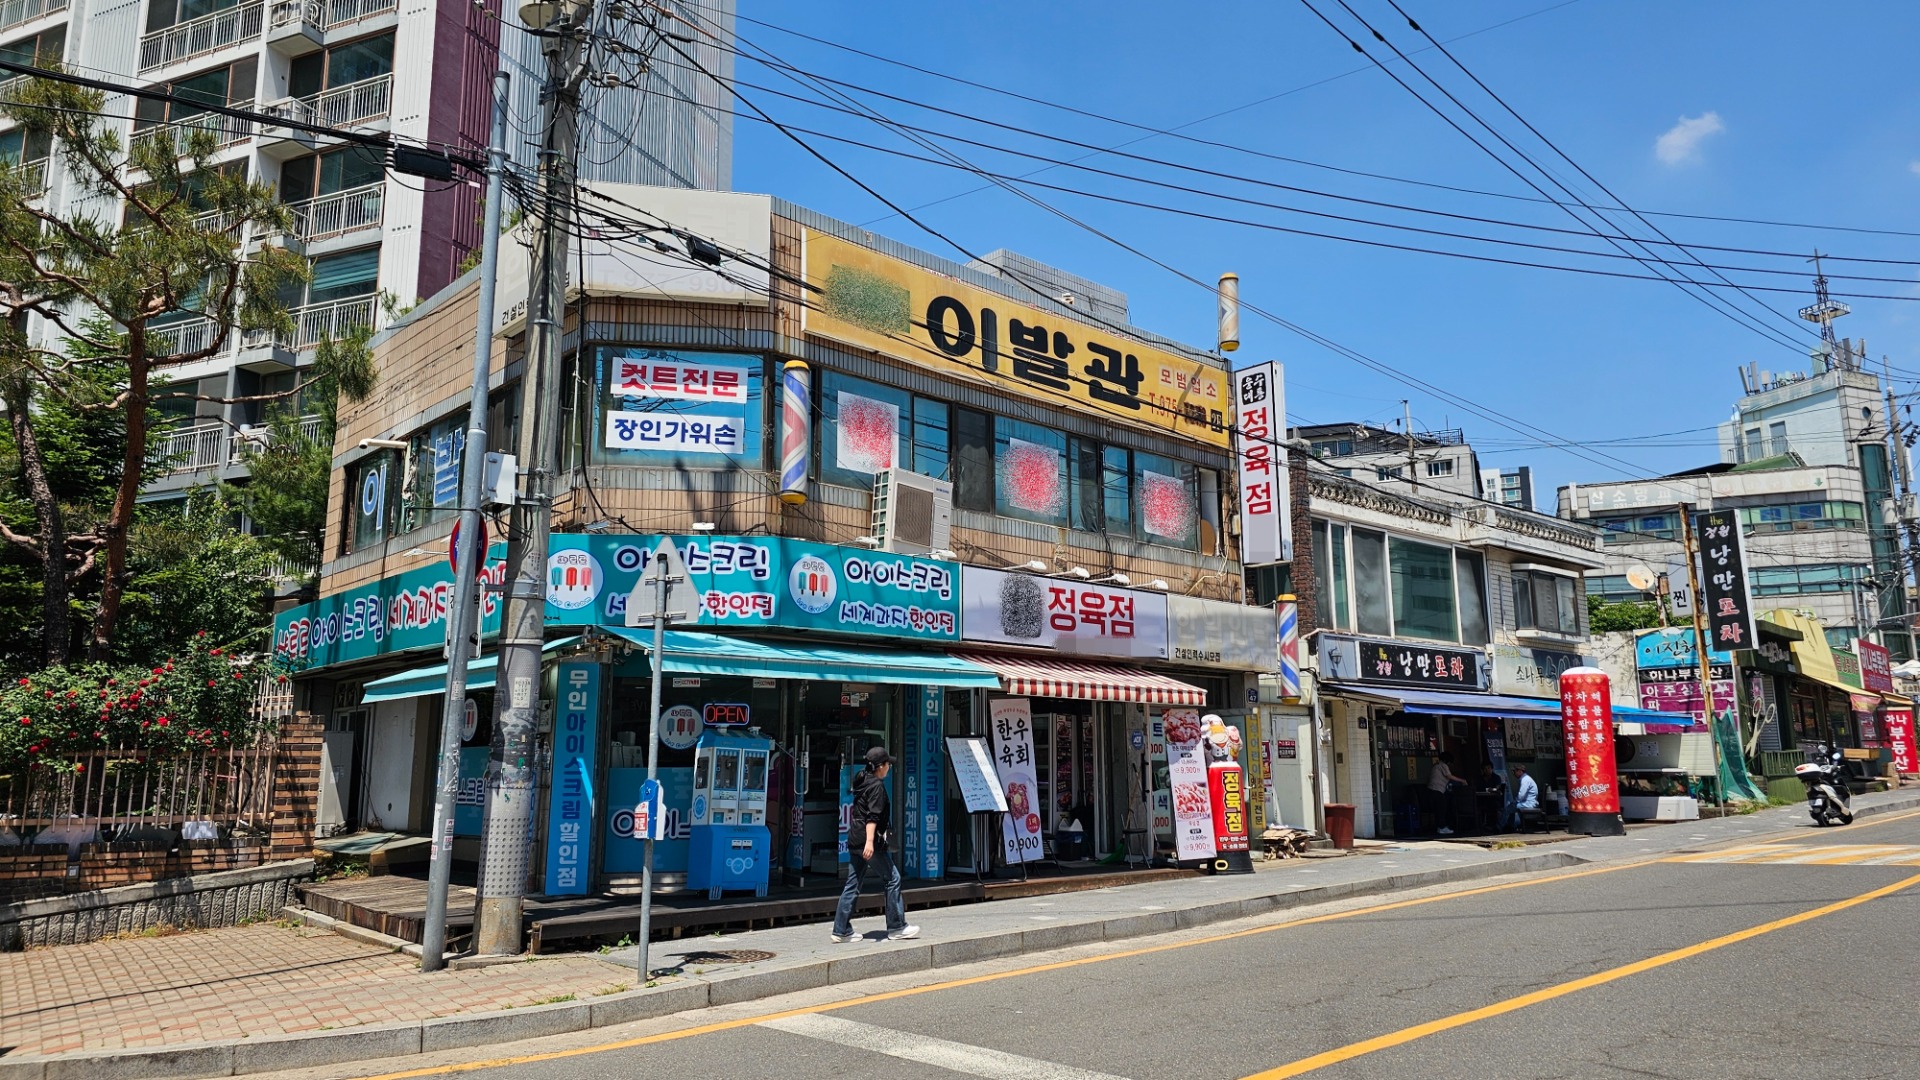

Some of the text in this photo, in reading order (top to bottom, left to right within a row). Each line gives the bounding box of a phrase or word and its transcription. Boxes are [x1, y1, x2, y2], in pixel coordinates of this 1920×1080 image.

[926, 295, 1145, 410] 이발관
[621, 363, 739, 397] 컷트전문
[1160, 368, 1217, 398] 모범업소
[614, 418, 736, 446] 장인가위손
[1242, 406, 1272, 514] 정육점
[1705, 525, 1730, 538] 정원
[1710, 517, 1723, 526] the
[617, 544, 767, 578] 아스크림
[846, 560, 950, 597] 아이스크림
[609, 592, 773, 617] 세할인점
[1710, 545, 1744, 643] 낭만포차
[841, 603, 954, 633] 세계과자할인점
[1048, 586, 1136, 638] 정육점
[1400, 651, 1464, 681] 낭만포차
[705, 705, 749, 723] OPEN
[1885, 714, 1908, 725] 하나
[997, 717, 1029, 742] 한우
[999, 743, 1030, 768] 육회
[1889, 726, 1910, 771] 부동산
[1008, 836, 1039, 854] 9,900
